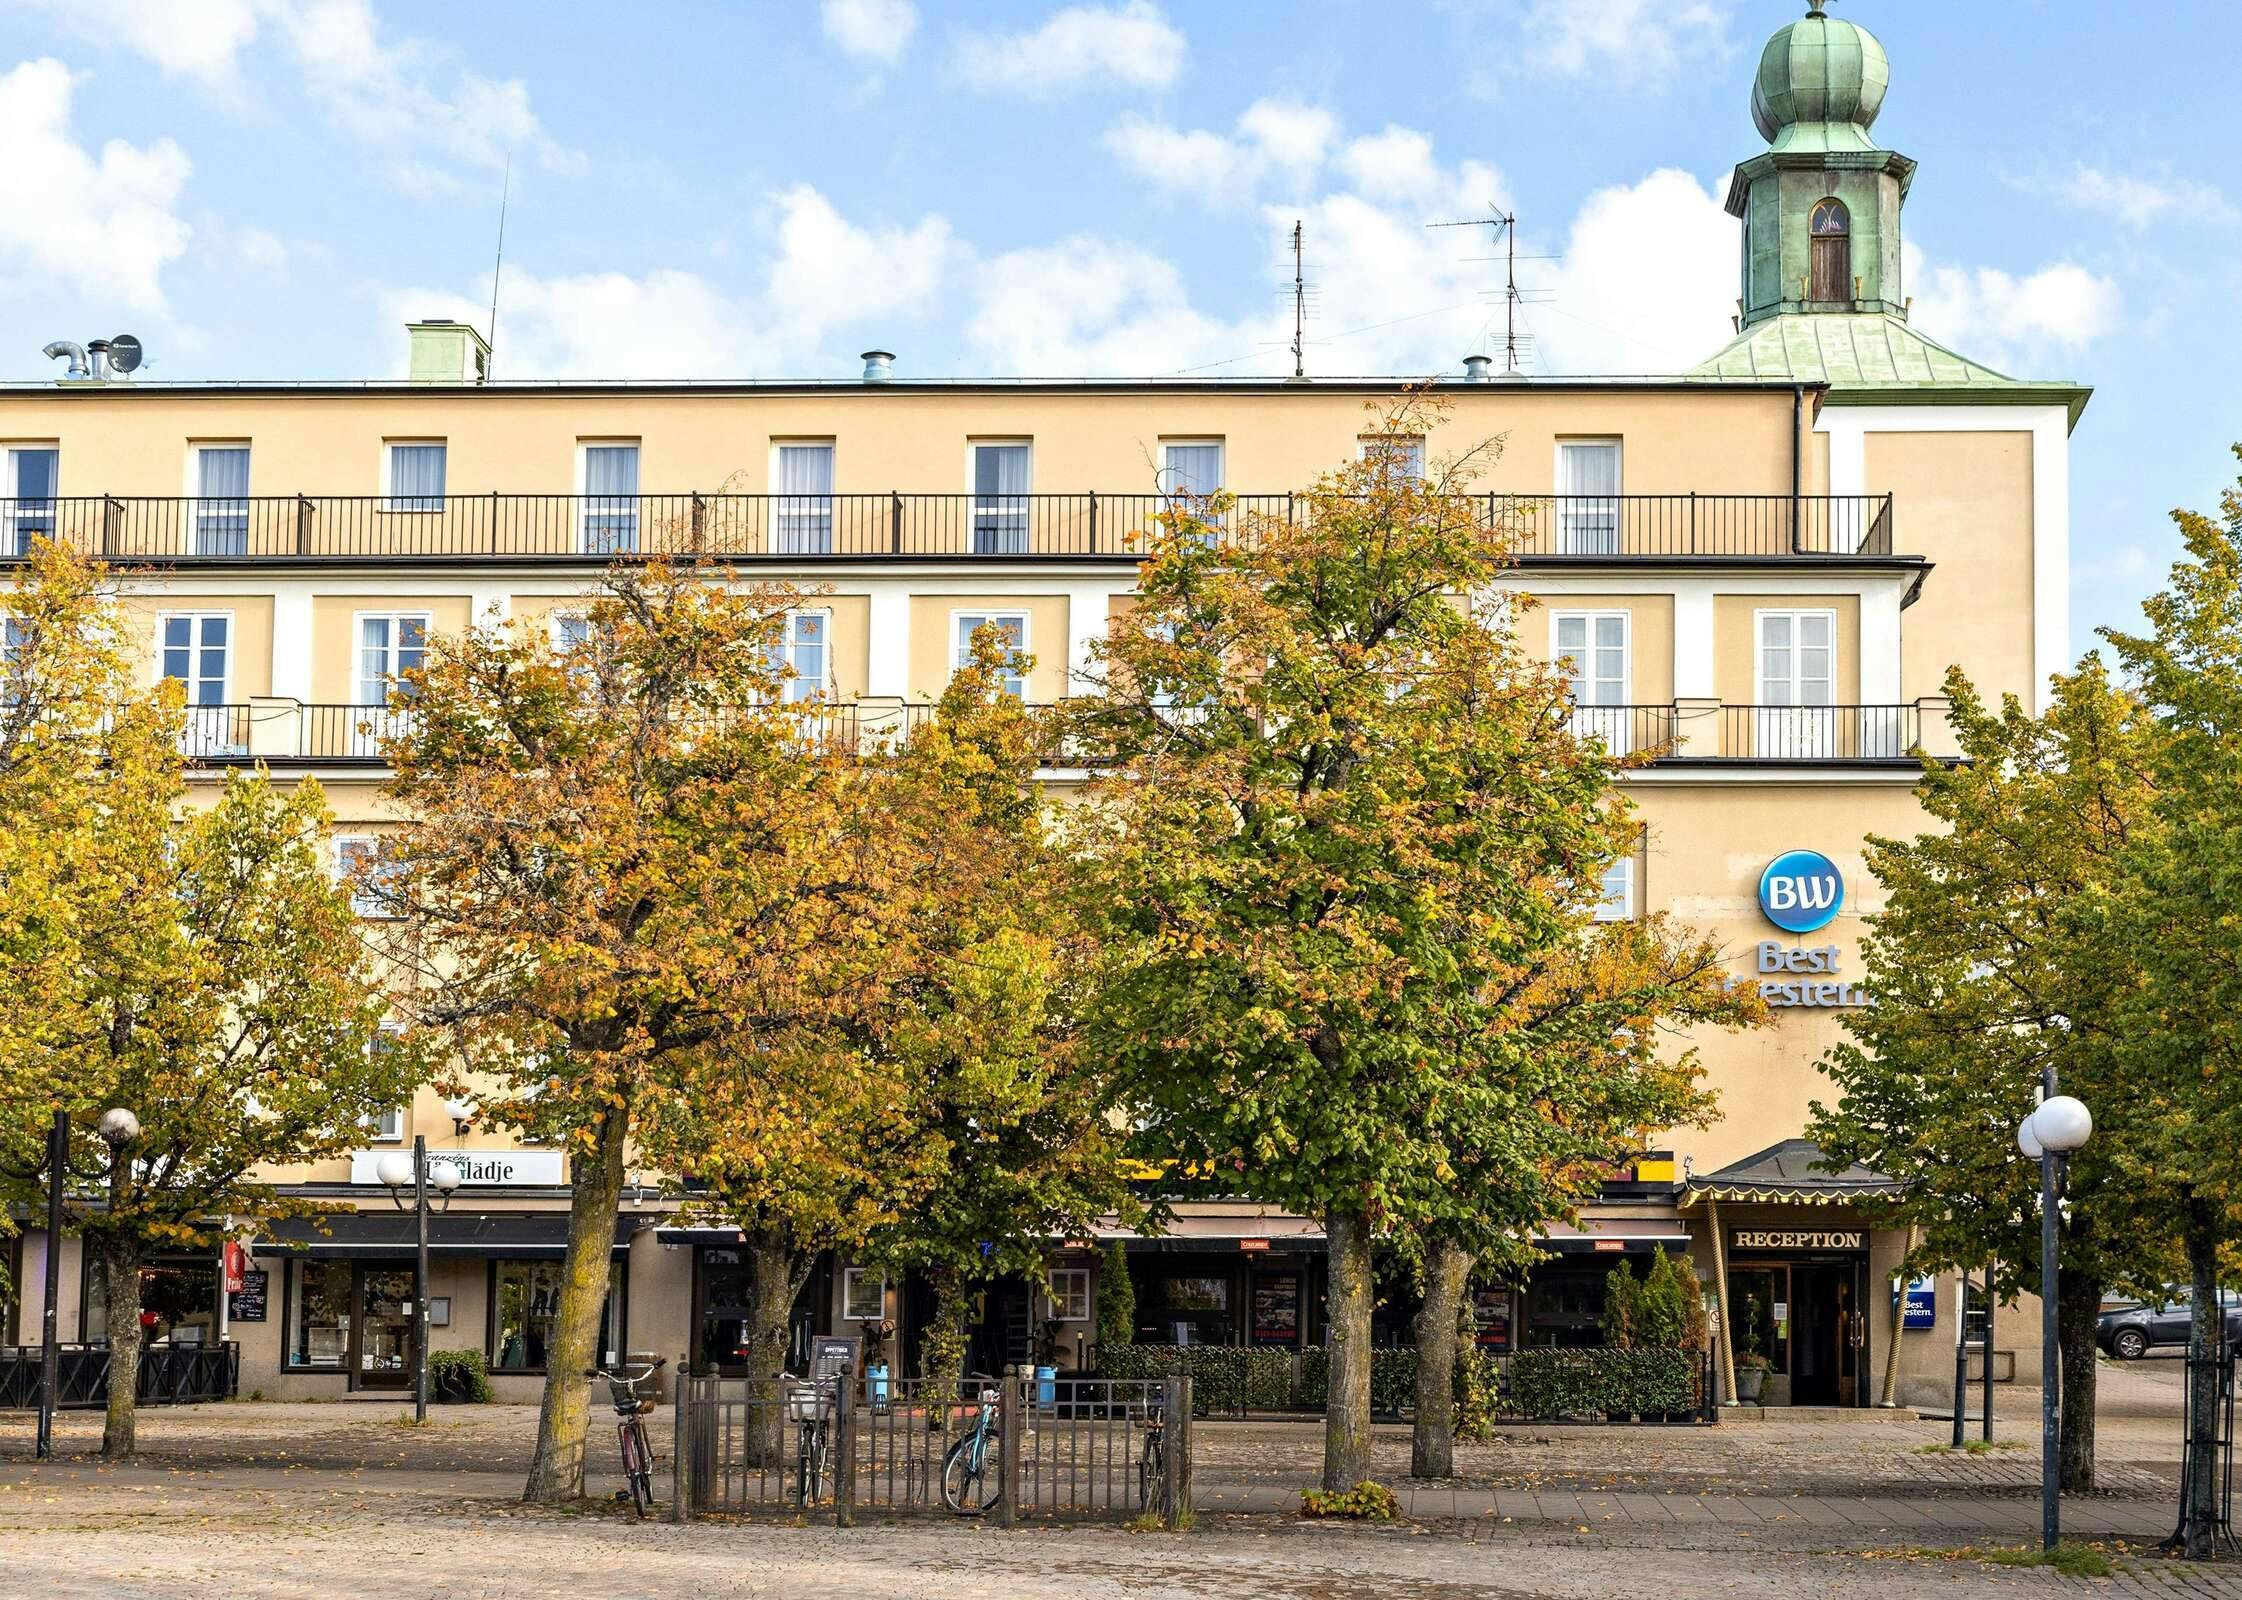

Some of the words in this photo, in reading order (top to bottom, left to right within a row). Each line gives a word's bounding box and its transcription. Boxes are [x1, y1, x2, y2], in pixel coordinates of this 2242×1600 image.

[1769, 876, 1836, 910] BW
[1758, 940, 1842, 974] Best
[425, 1152, 470, 1162] ranzéns
[1735, 1231, 1862, 1248] RECEPTION
[1905, 1301, 1924, 1309] Best
